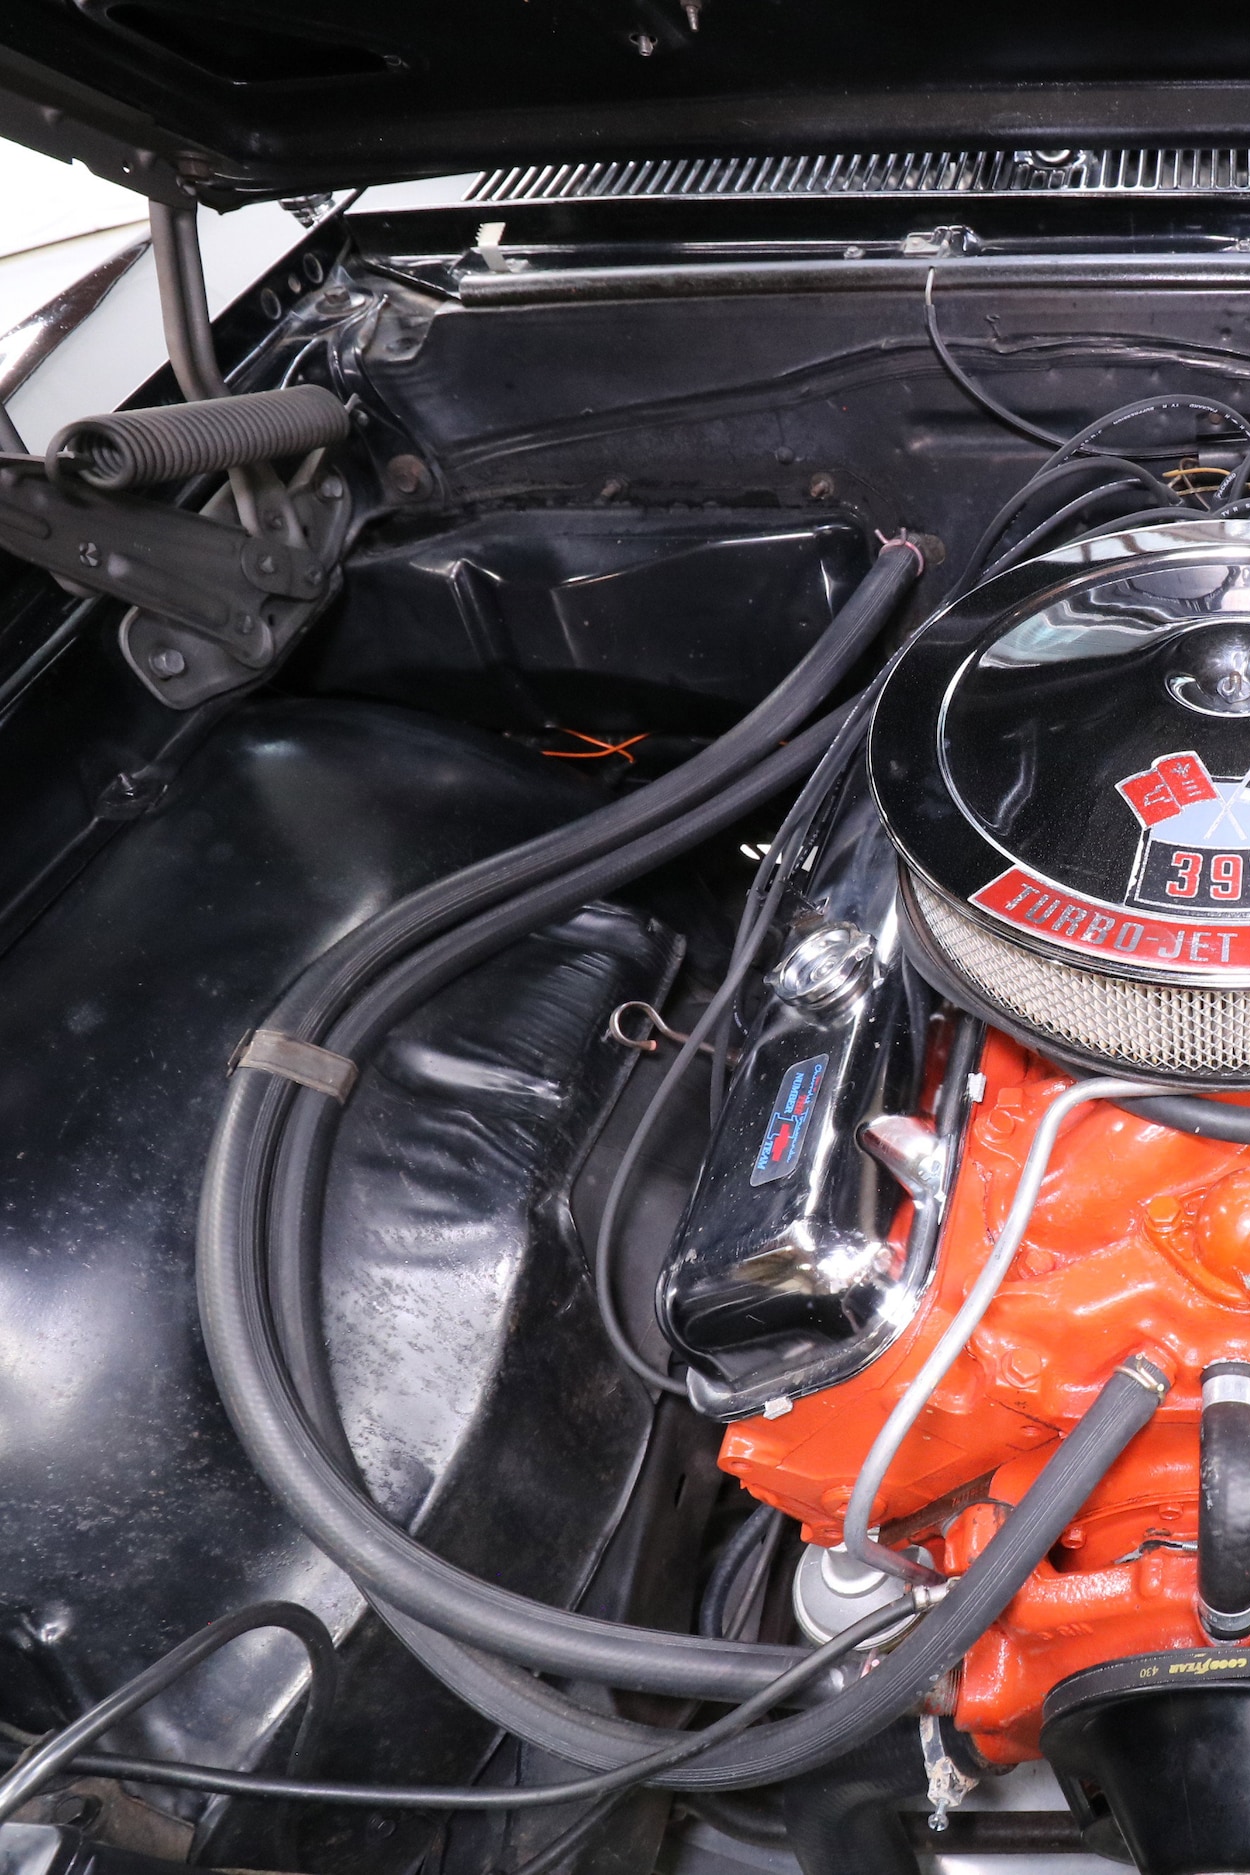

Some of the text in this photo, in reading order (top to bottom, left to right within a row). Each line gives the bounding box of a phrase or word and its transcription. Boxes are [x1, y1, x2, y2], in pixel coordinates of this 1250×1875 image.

[1003, 882, 1239, 963] TURBO-JET
[784, 1072, 805, 1114] NUMBER
[756, 1140, 774, 1171] TEAM
[1139, 1665, 1160, 1680] 430
[1168, 1657, 1249, 1676] GOODYEAR
